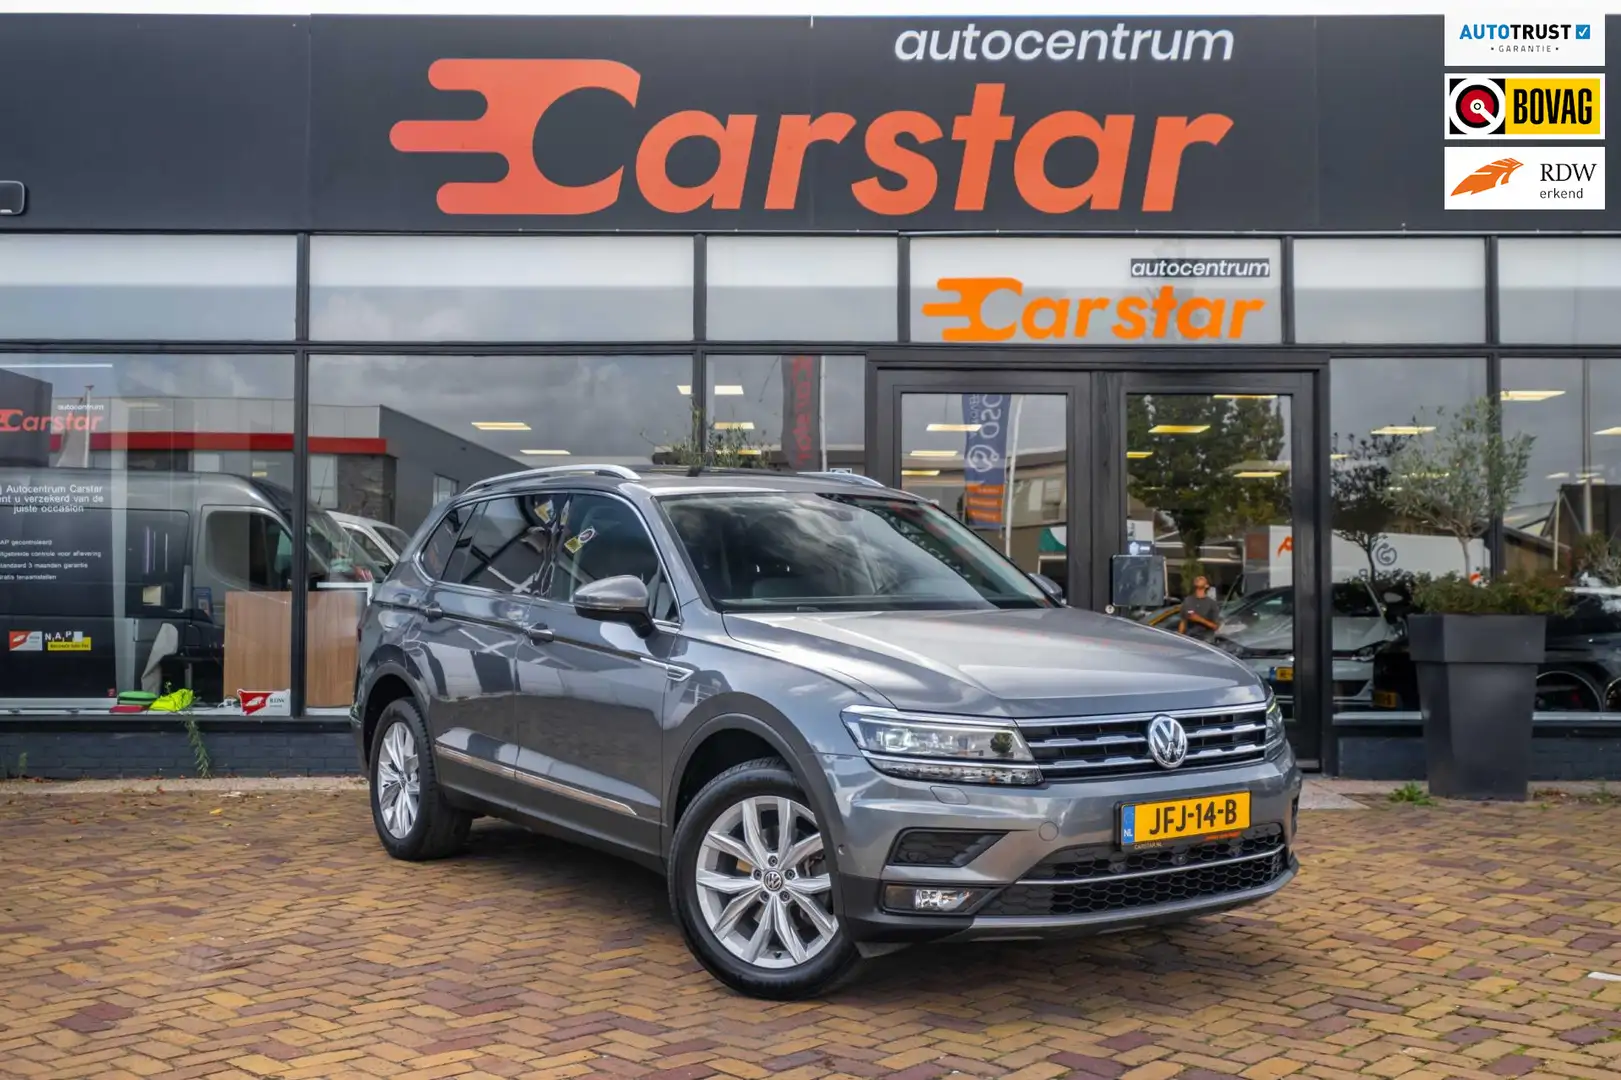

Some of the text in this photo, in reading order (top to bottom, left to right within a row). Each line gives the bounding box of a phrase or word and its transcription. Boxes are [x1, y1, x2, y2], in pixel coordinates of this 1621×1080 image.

[894, 22, 1235, 62] autocentrum
[390, 58, 1234, 215] Carstar
[1131, 258, 1270, 278] autocentrum
[922, 276, 1265, 343] Carstar
[57, 403, 104, 411] autocentrum
[0, 408, 104, 432] Carstar
[6, 484, 66, 493] Autocentrum
[69, 484, 103, 493] Carstar
[13, 504, 84, 514] juiste occasion
[24, 495, 70, 503] verzekerd
[92, 495, 104, 503] de
[1149, 799, 1237, 836] JFJ-14-B
[1123, 828, 1133, 838] NL
